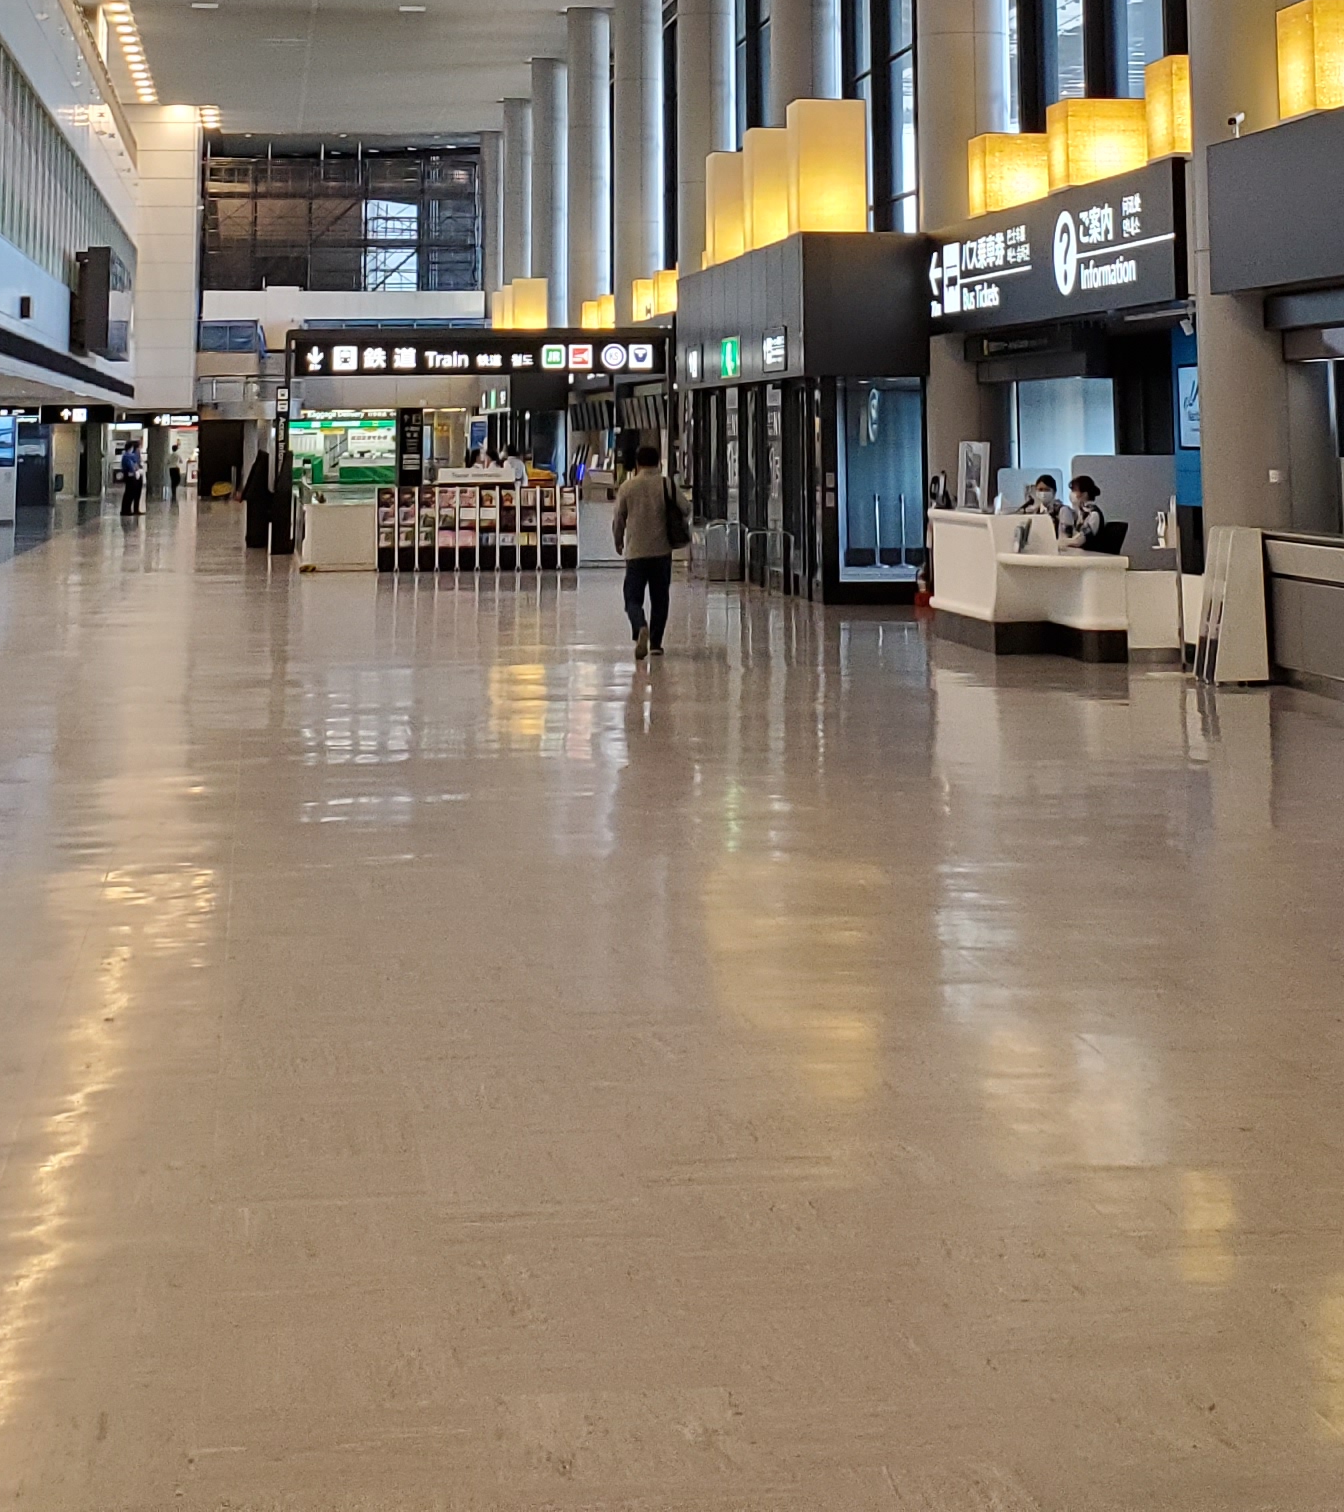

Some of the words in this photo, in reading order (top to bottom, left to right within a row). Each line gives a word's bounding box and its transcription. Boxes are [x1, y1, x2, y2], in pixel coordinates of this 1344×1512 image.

[1078, 202, 1114, 244] ご案内
[1080, 255, 1136, 289] Information
[363, 347, 417, 369] 鉄道
[424, 351, 470, 369] Train
